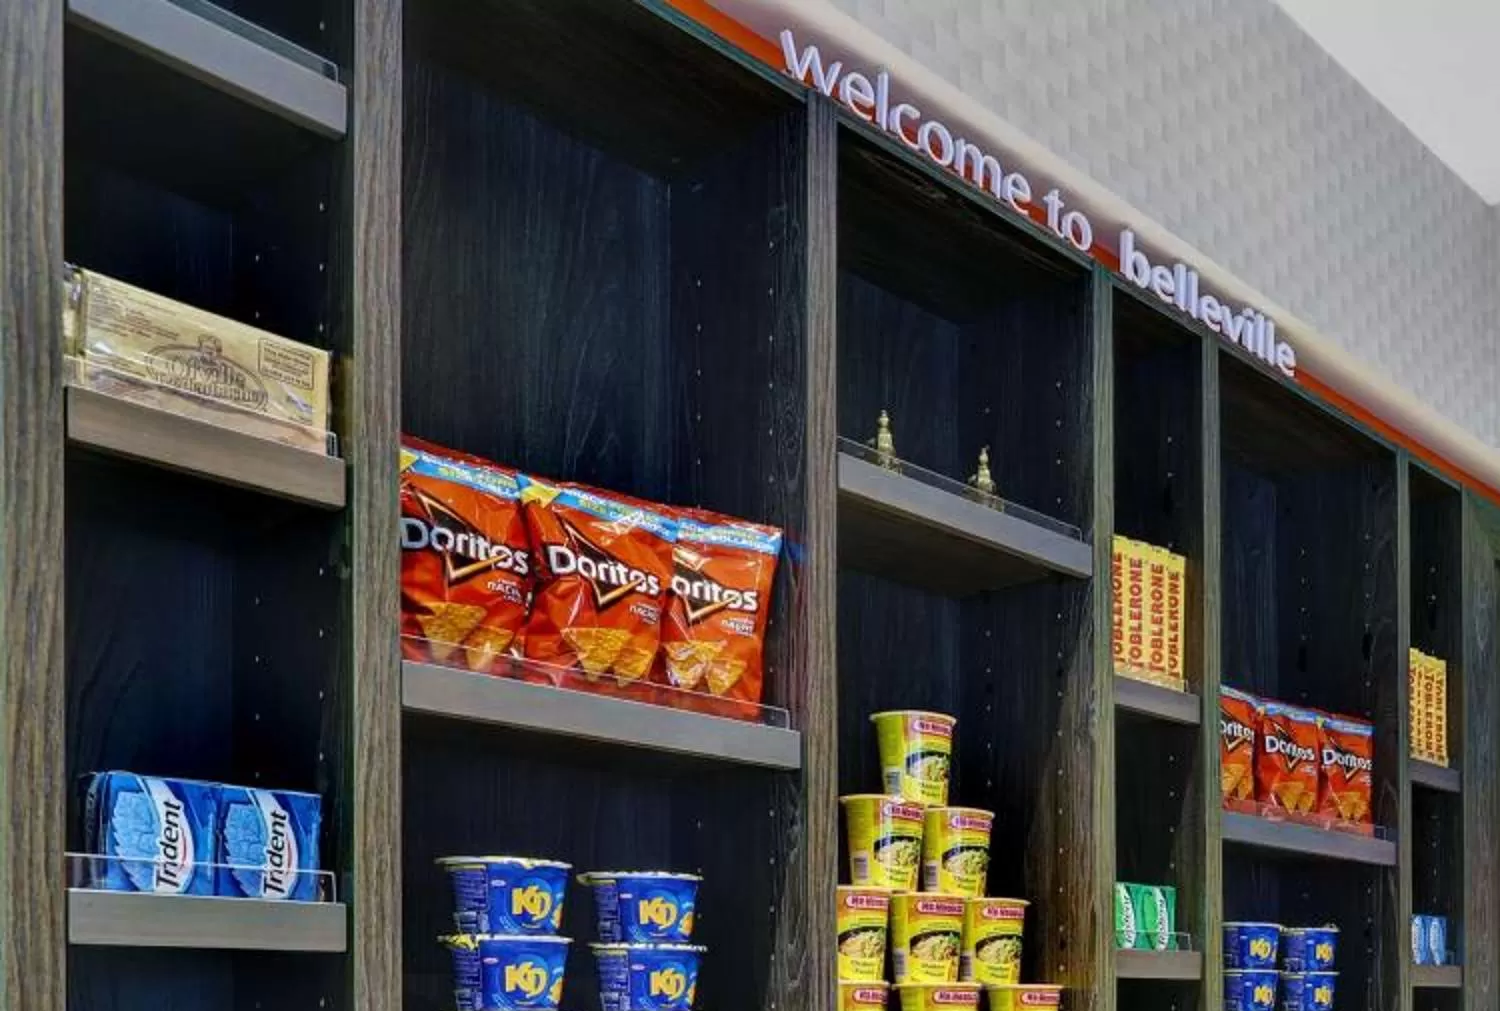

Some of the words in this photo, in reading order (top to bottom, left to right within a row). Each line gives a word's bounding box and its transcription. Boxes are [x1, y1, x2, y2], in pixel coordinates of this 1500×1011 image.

[779, 29, 1032, 215] welcome
[1043, 188, 1093, 252] to
[1119, 229, 1297, 377] belleville
[401, 517, 529, 575] Doritos
[549, 544, 660, 596] Doritos
[671, 572, 758, 612] oritos
[155, 798, 181, 892] Trident
[263, 809, 288, 897] Trident
